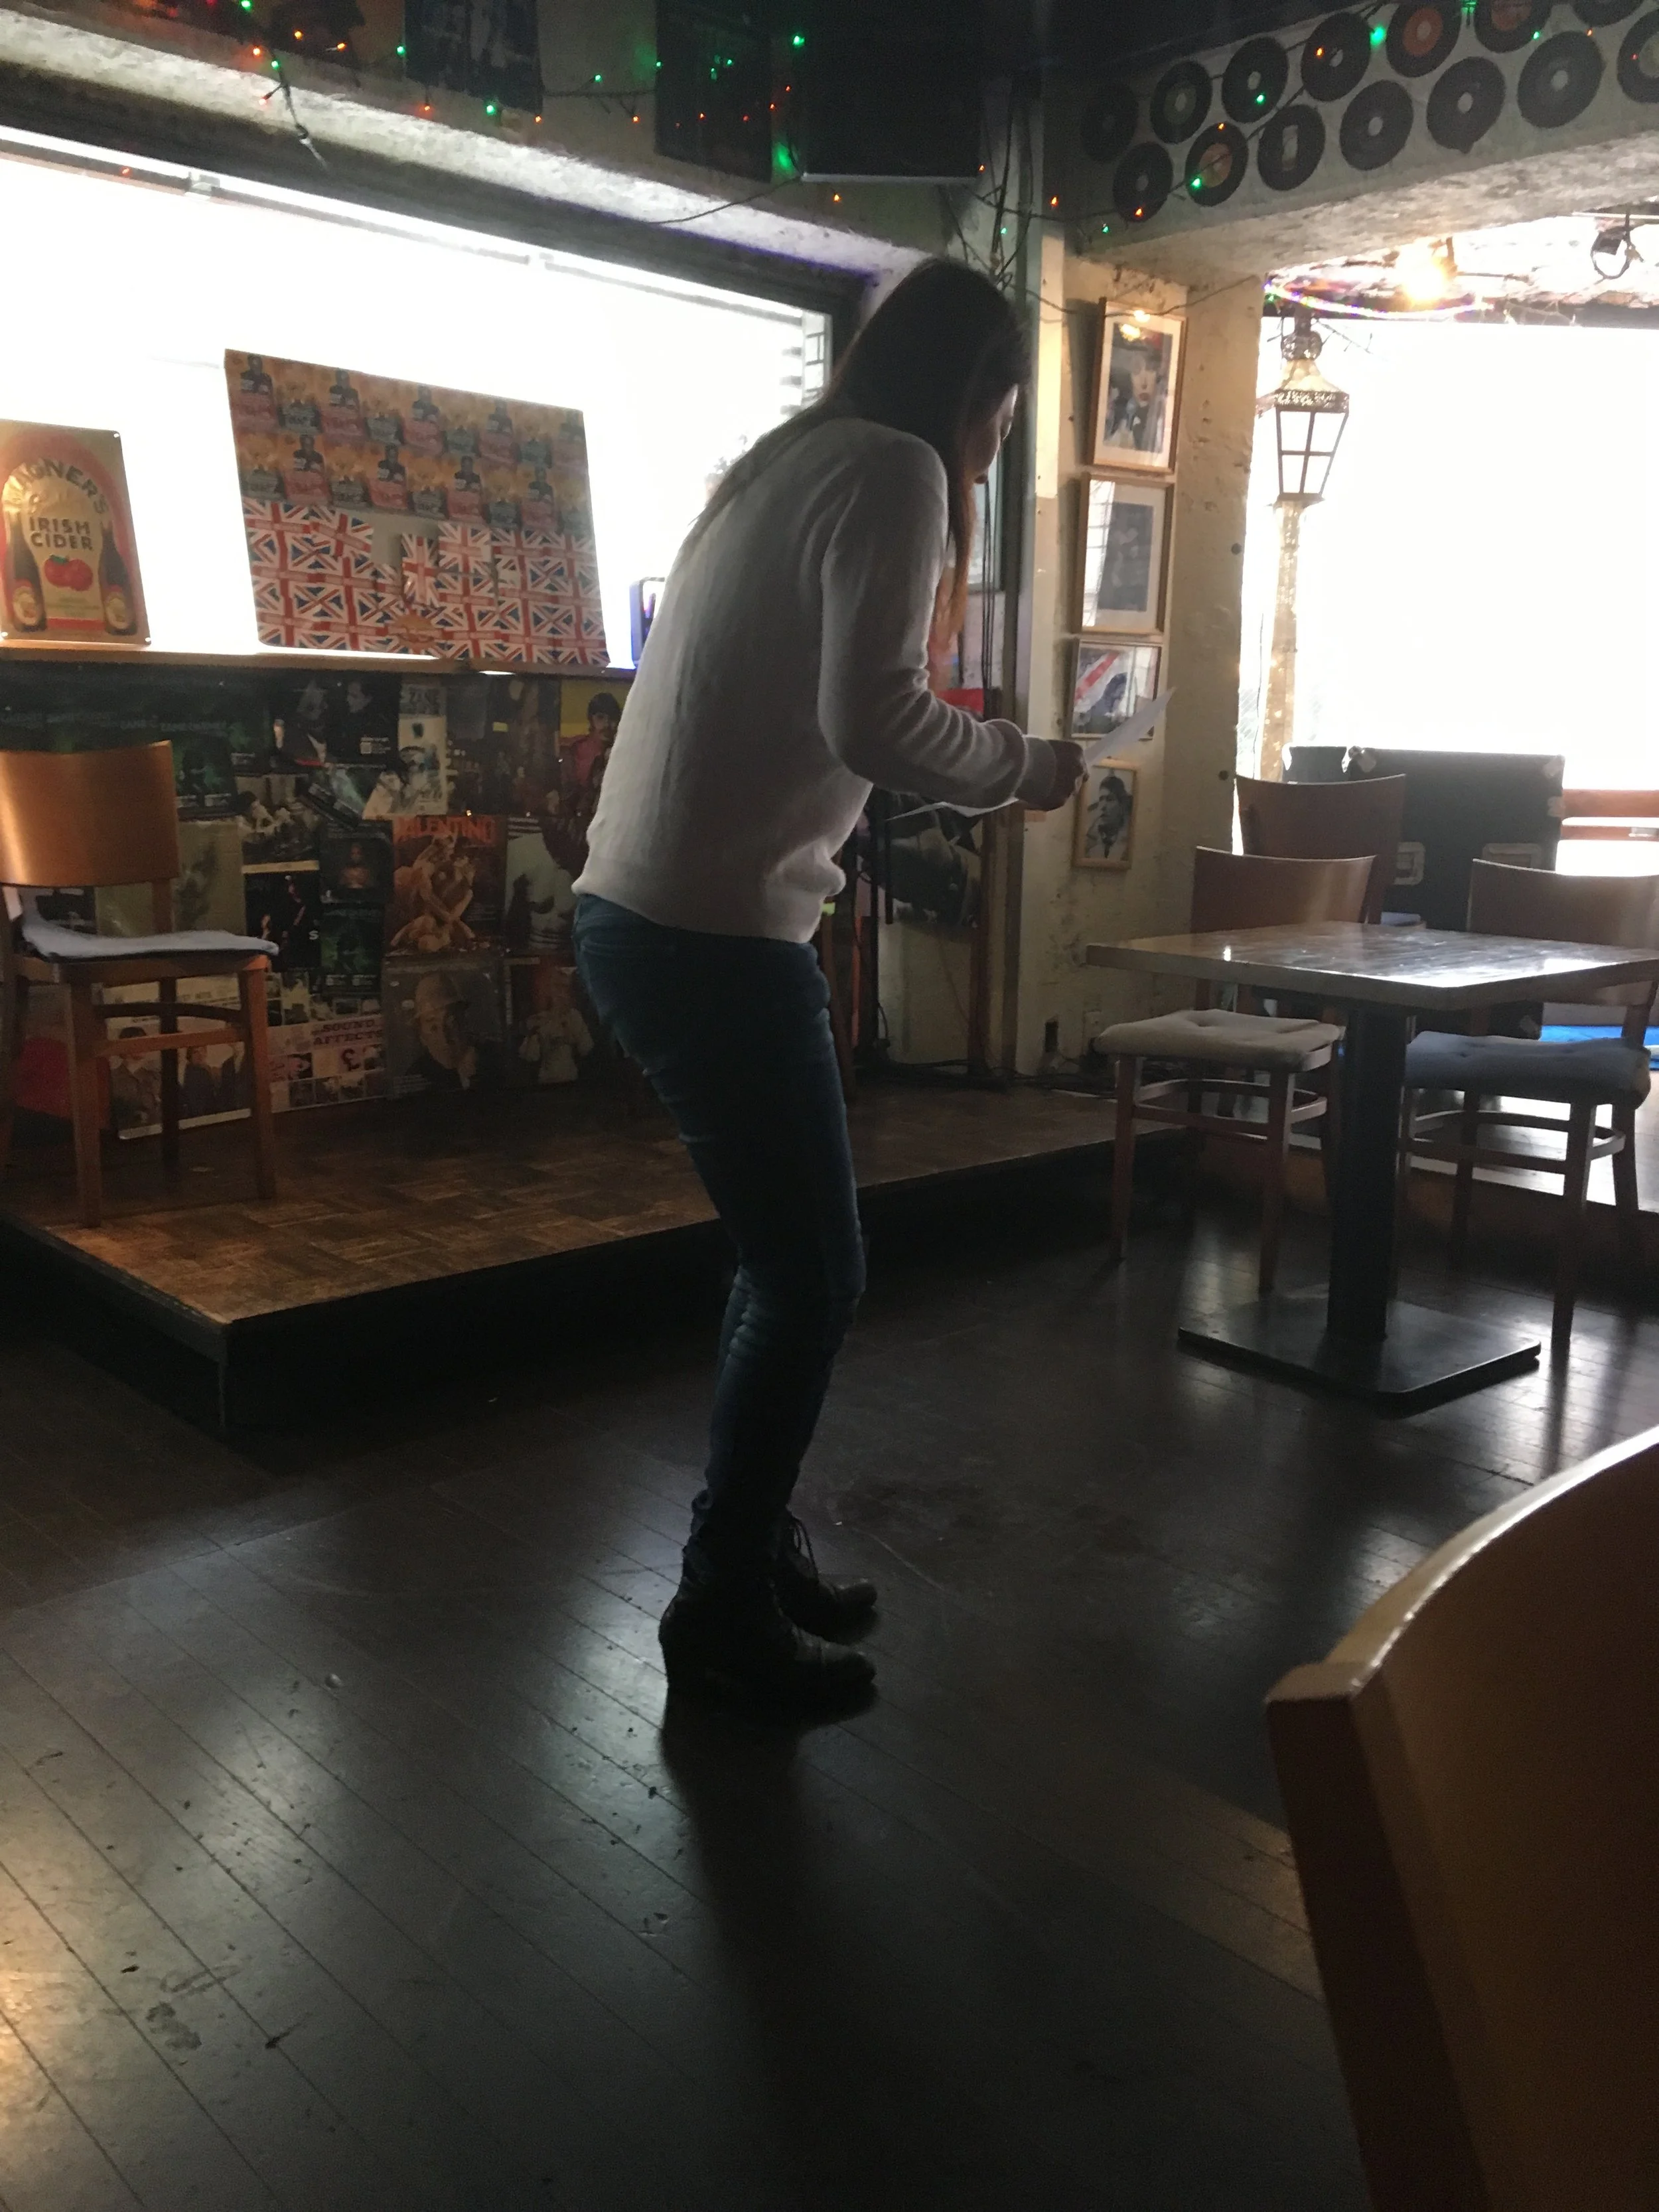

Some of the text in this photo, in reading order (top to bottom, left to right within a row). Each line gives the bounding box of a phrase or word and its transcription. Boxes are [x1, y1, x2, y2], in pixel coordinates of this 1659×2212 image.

[30, 517, 90, 534] IRISH
[30, 532, 94, 550] CIDER
[396, 816, 496, 844] VALENTINO
[323, 1019, 376, 1032] SOUND
